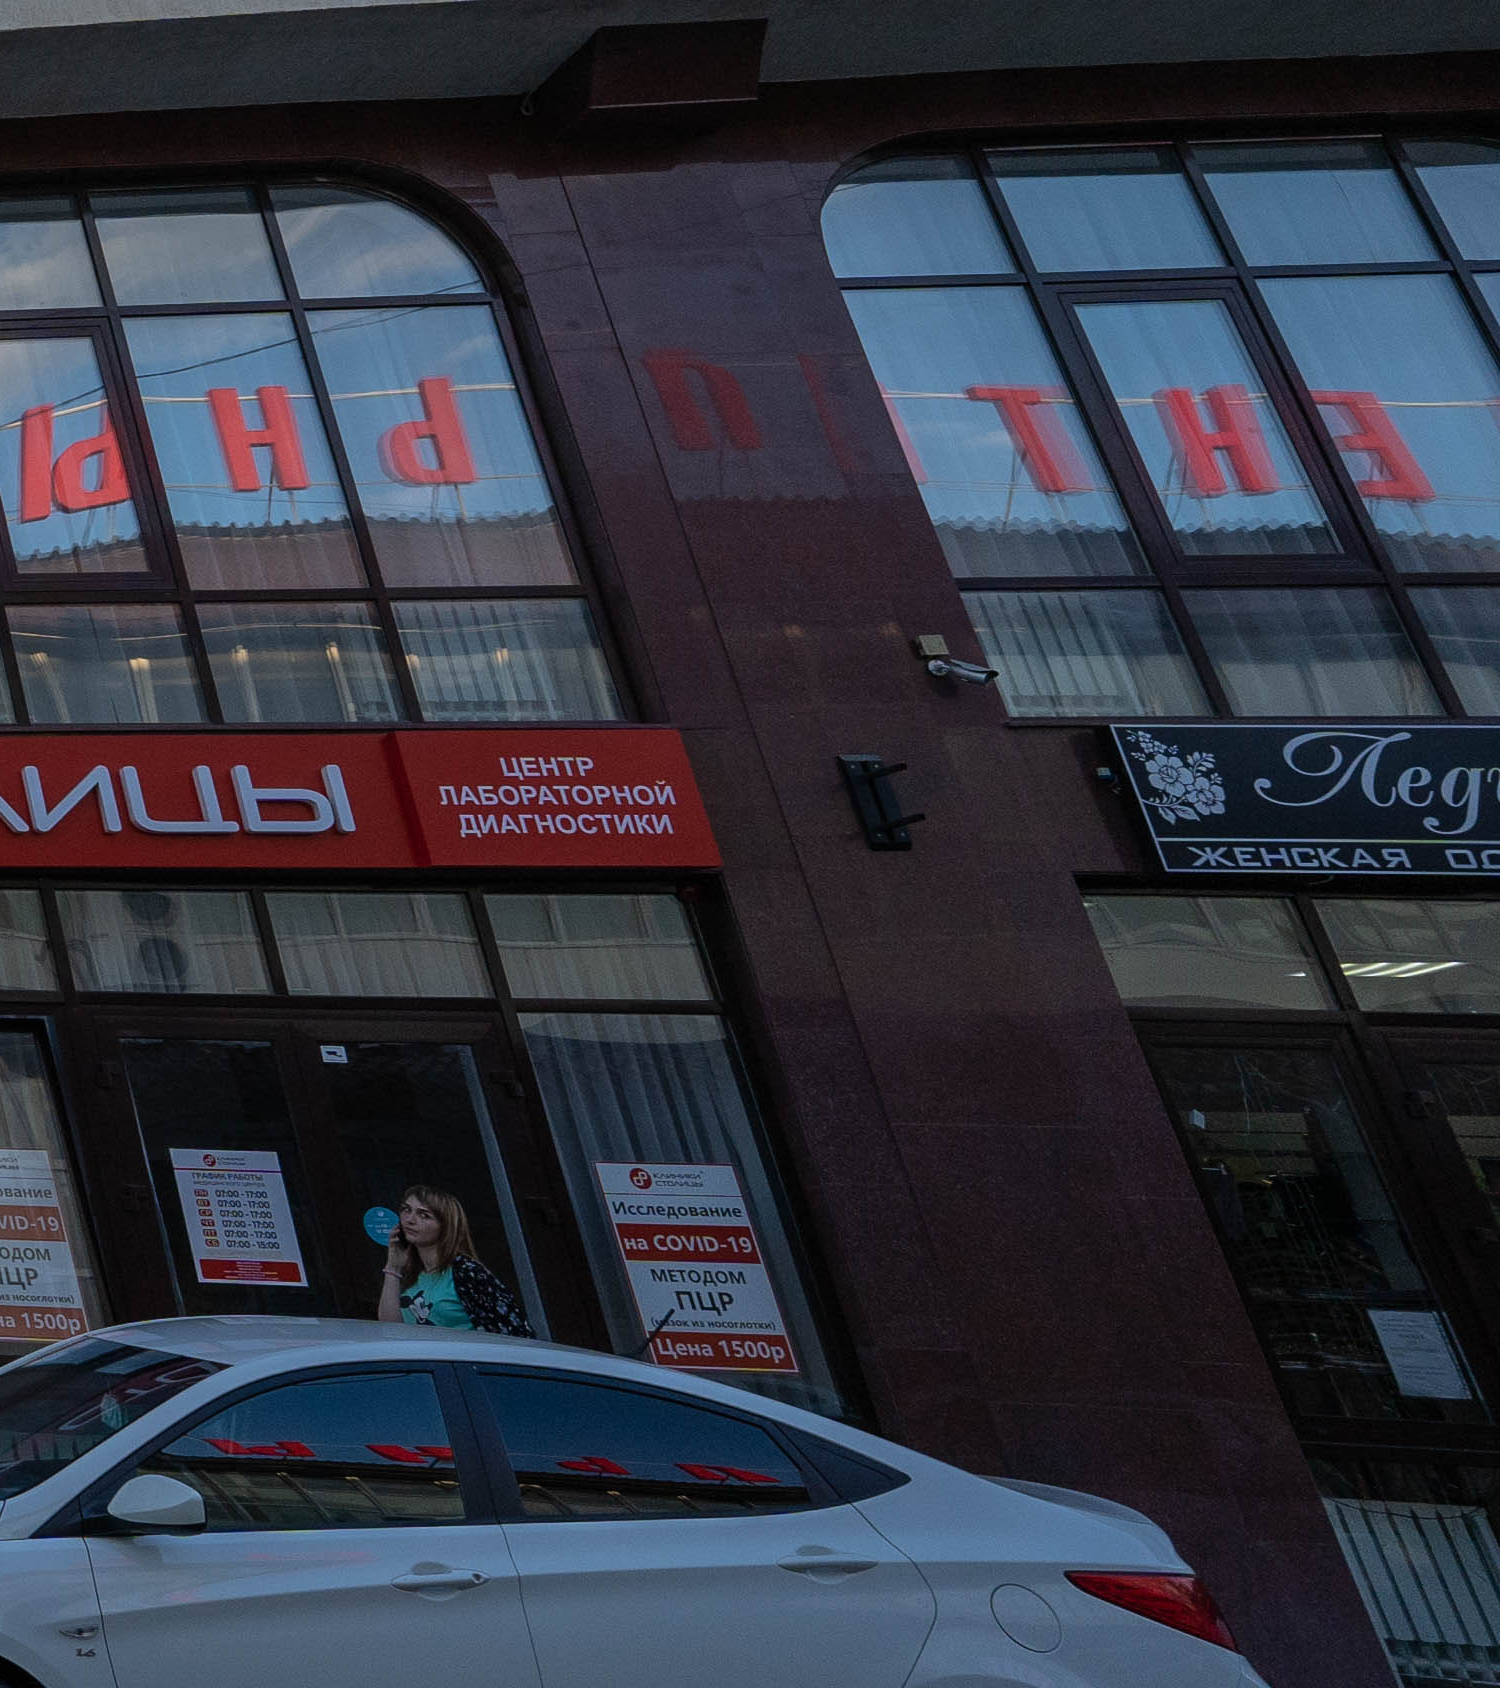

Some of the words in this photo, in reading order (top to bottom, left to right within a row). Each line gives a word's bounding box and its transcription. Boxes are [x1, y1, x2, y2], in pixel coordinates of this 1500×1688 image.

[499, 756, 595, 781] ЦЕНТР
[1253, 731, 1500, 835] Лед
[438, 780, 677, 806] ЛАБОРАТОРНОЙ
[459, 814, 674, 839] ДИАГНОСТИКИ
[1187, 846, 1412, 869] ЖЕНСКАЯ
[215, 1190, 239, 1198] 07:00
[217, 1200, 241, 1208] 07:00
[612, 1201, 743, 1219] Исследование
[220, 1210, 243, 1218] 07:00
[222, 1220, 246, 1228] 07:00
[224, 1230, 248, 1238] 07:00
[625, 1238, 649, 1251] на
[653, 1234, 753, 1253] COVID-19
[650, 1269, 747, 1287] МЕТОДОМ
[12, 1293, 75, 1304] носоглотки)
[675, 1290, 734, 1316] ПЦР
[21, 1313, 81, 1335] 1500р
[692, 1319, 705, 1328] из
[708, 1319, 776, 1331] носоглотки)
[655, 1339, 715, 1359] Цена
[718, 1341, 785, 1363] 1500р
